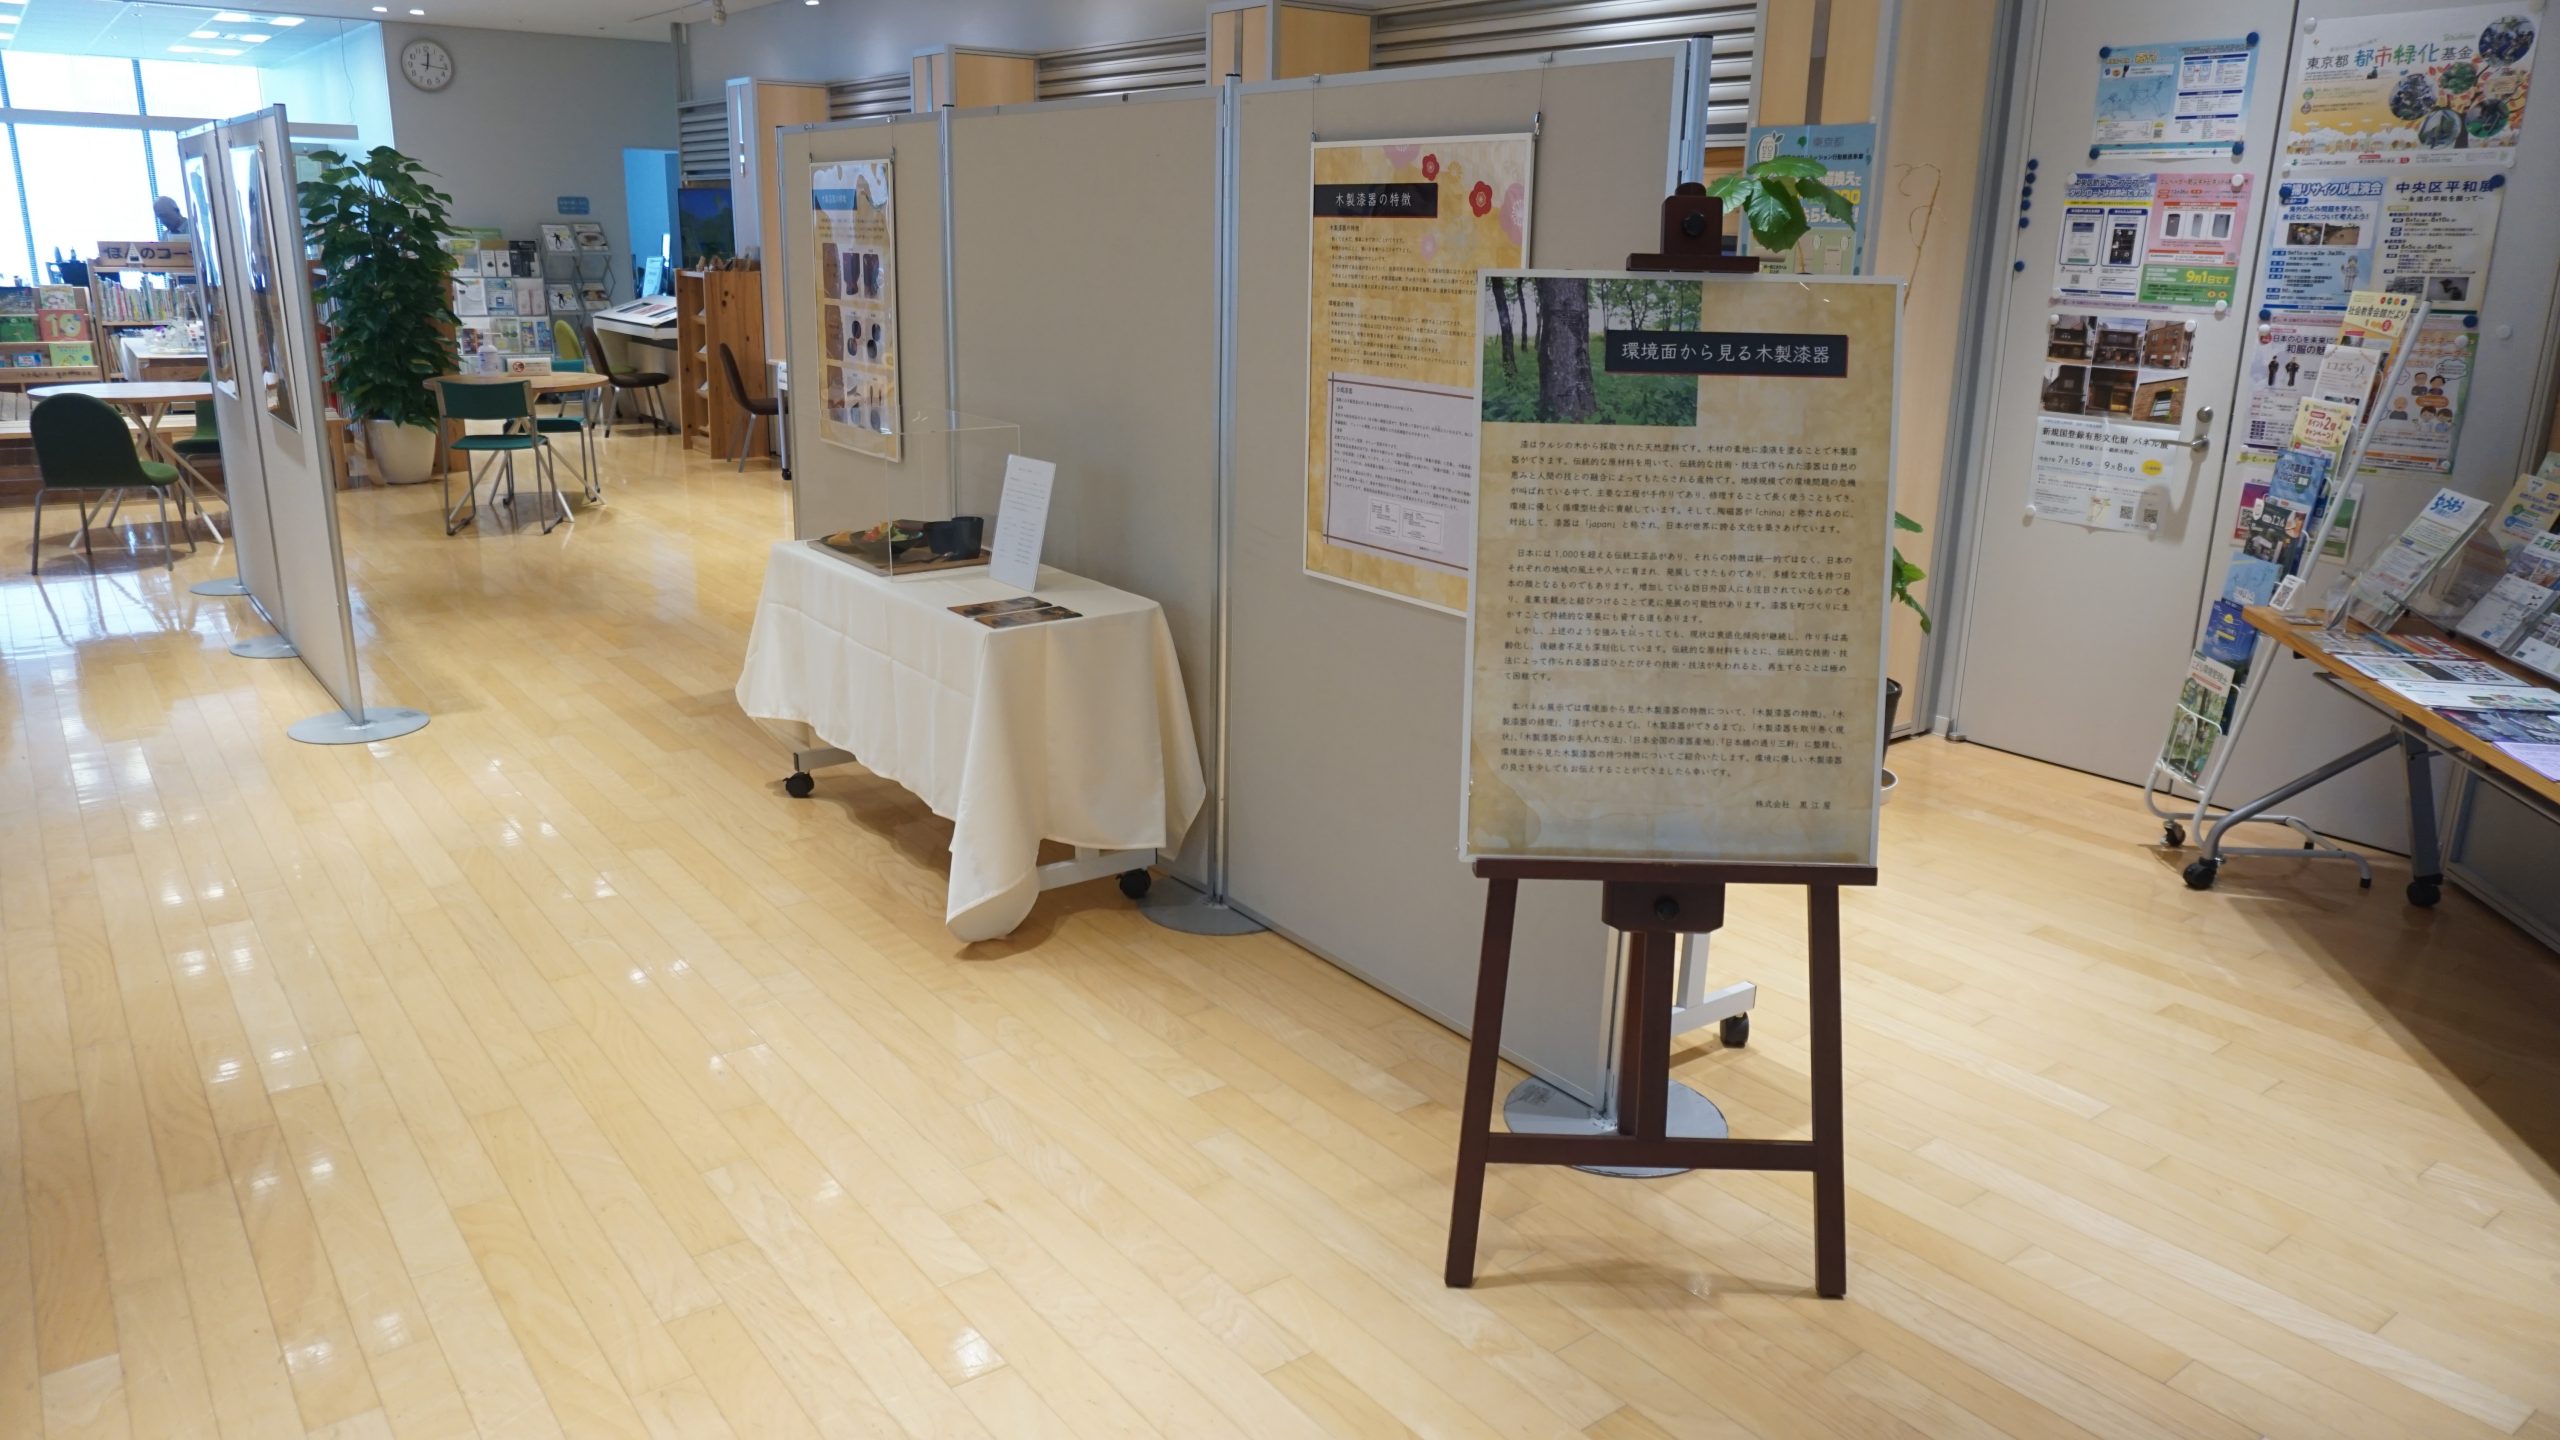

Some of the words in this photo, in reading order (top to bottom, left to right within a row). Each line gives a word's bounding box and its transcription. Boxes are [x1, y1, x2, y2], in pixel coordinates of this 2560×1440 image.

[2307, 54, 2349, 69] 東京都
[2354, 42, 2474, 67] 都市緑化基金
[1335, 192, 1412, 207] 木製漆器の特徴
[2348, 304, 2408, 321] 社会教育会館だより
[1621, 342, 1830, 364] 環境面から見る木製漆器
[2042, 427, 2128, 445] 新規国登録有形文化財
[1503, 671, 1552, 682] て困難です。
[1755, 799, 1790, 809] 株式会社
